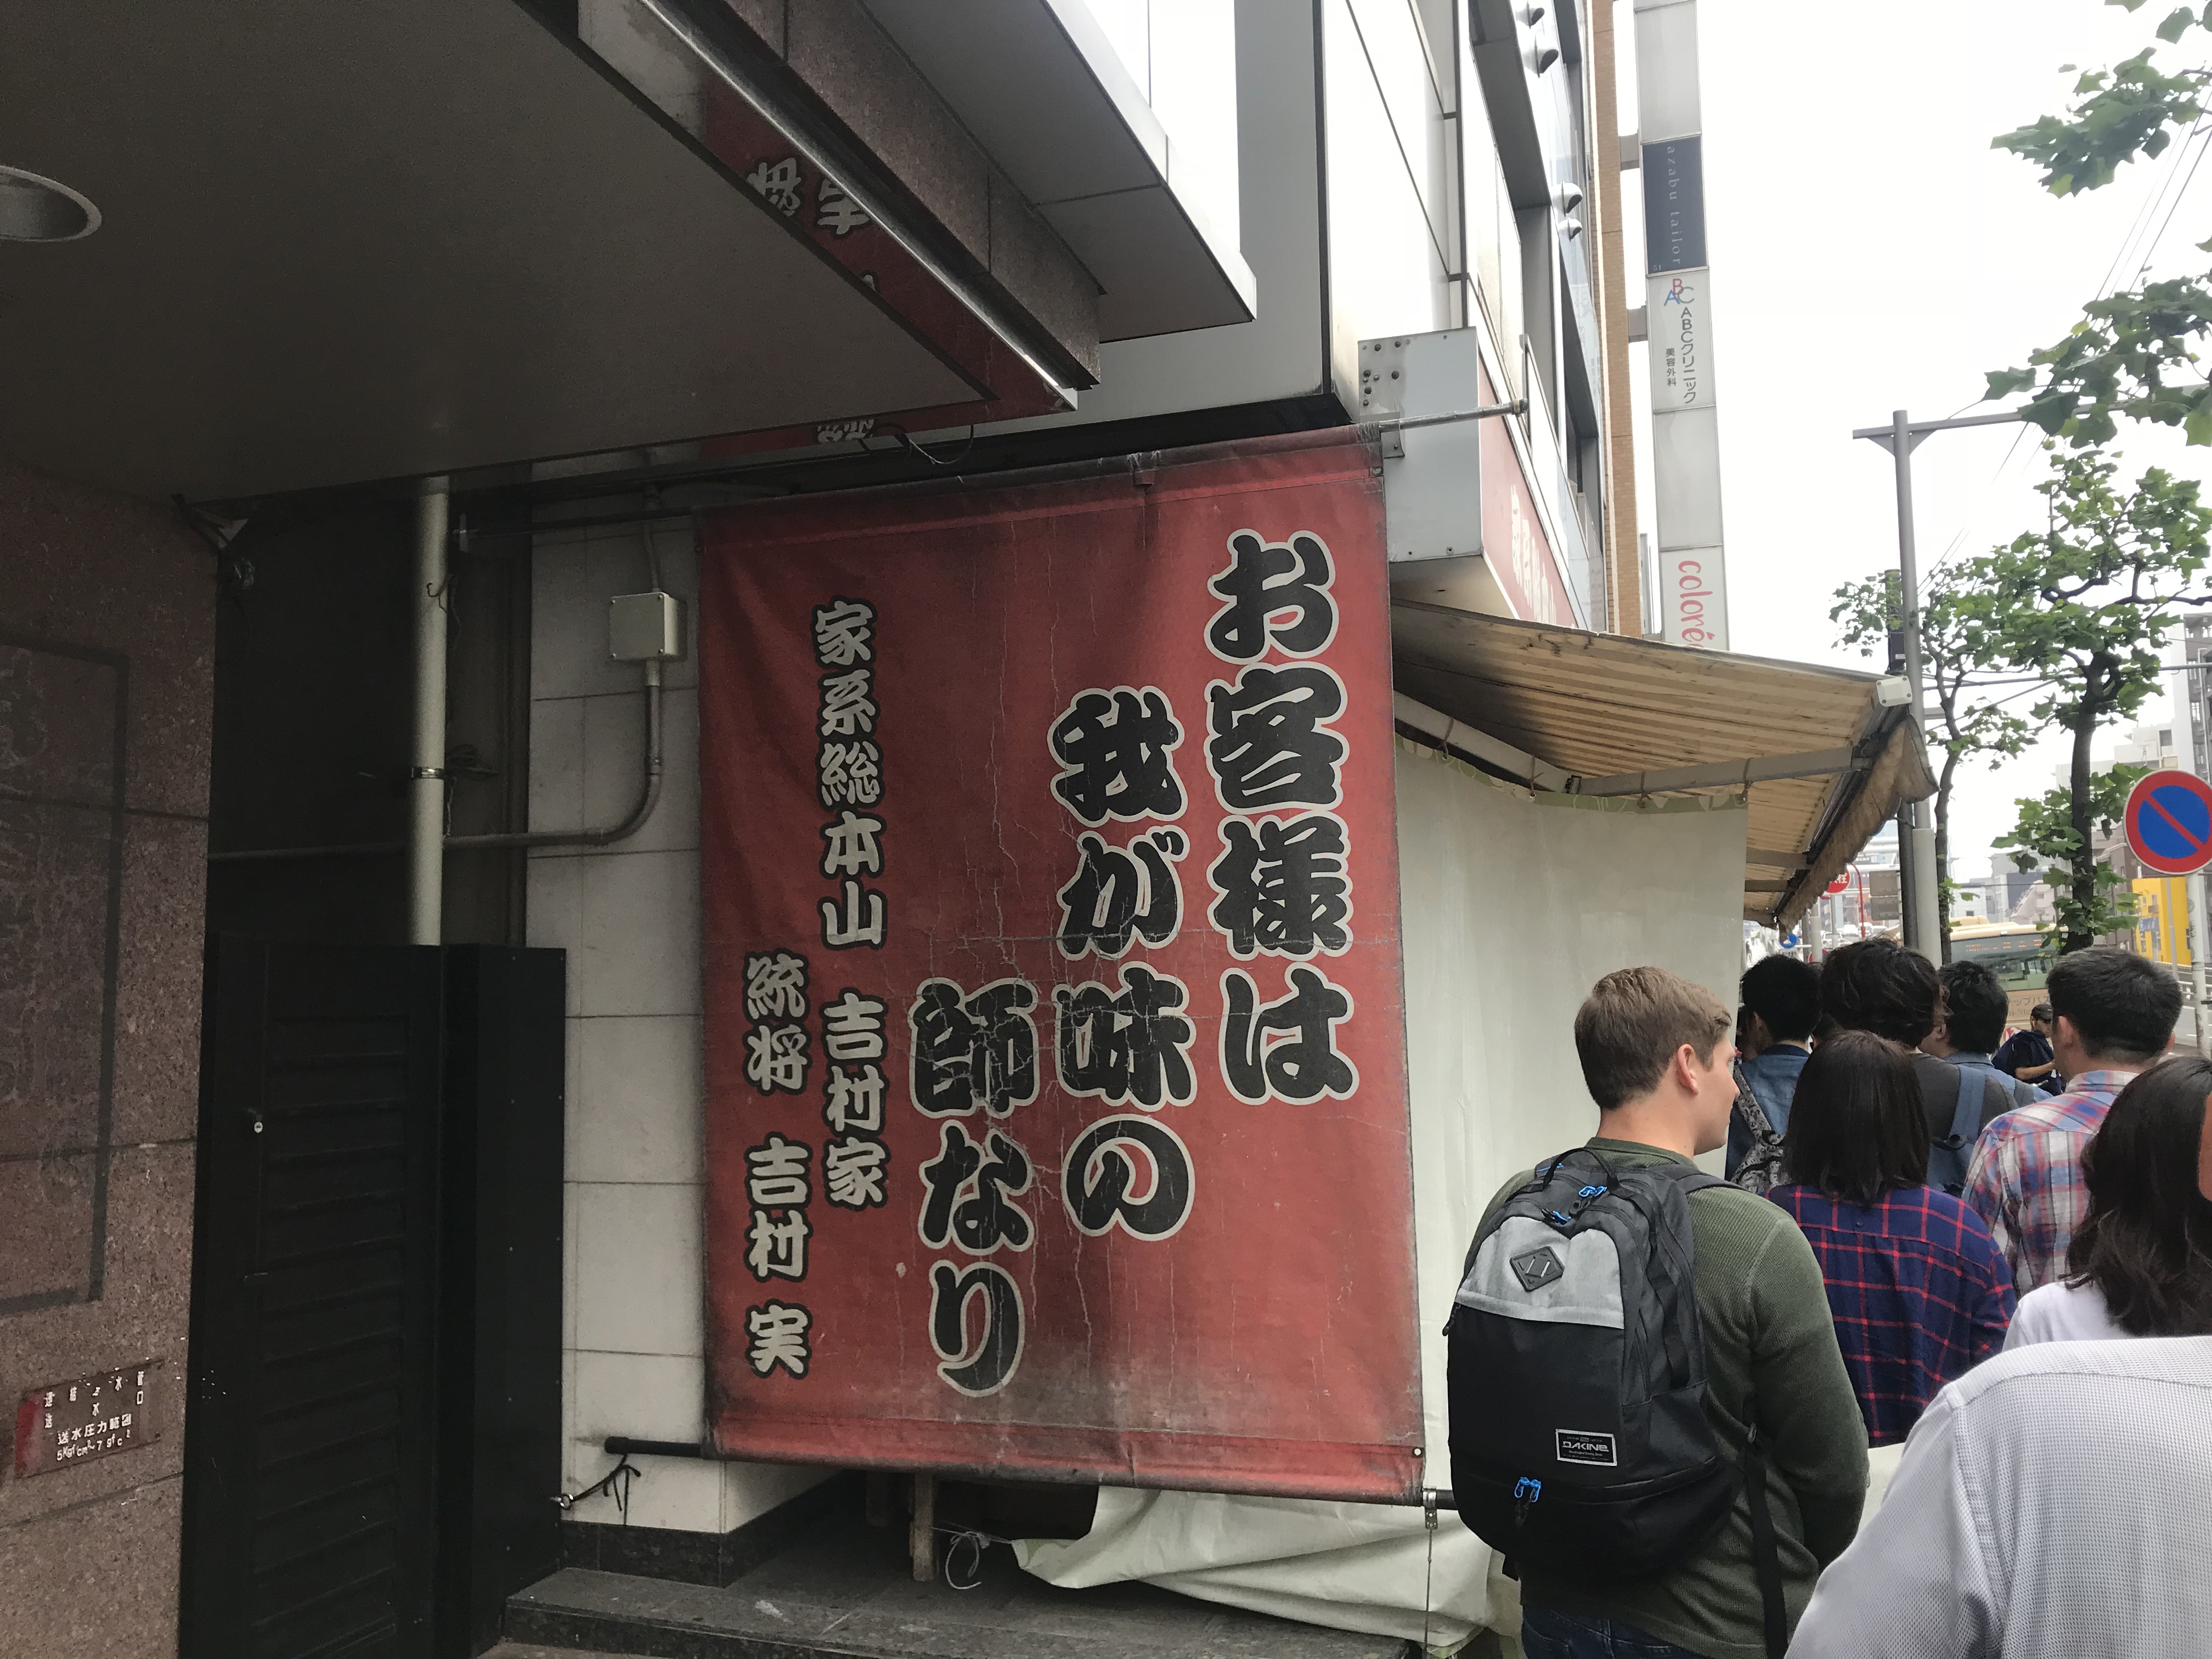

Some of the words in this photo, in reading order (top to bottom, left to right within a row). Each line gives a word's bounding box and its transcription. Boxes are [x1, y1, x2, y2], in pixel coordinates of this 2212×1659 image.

[1667, 146, 1680, 200] azabu
[1671, 211, 1683, 264] tailor
[1663, 278, 1695, 307] ABC
[1666, 347, 1677, 387] 美容外科
[1680, 306, 1696, 404] ABCクリニック
[1678, 560, 1716, 649] coloré
[813, 599, 884, 948] 家系総本山
[1204, 528, 1359, 1105] お客様は
[1049, 686, 1199, 1242] 我が味の
[822, 990, 887, 1209] 吉村家
[747, 1135, 811, 1279] 吉村
[908, 975, 1040, 1398] 師なり
[747, 1302, 810, 1375] 実
[1562, 1441, 1610, 1453] DAKINE
